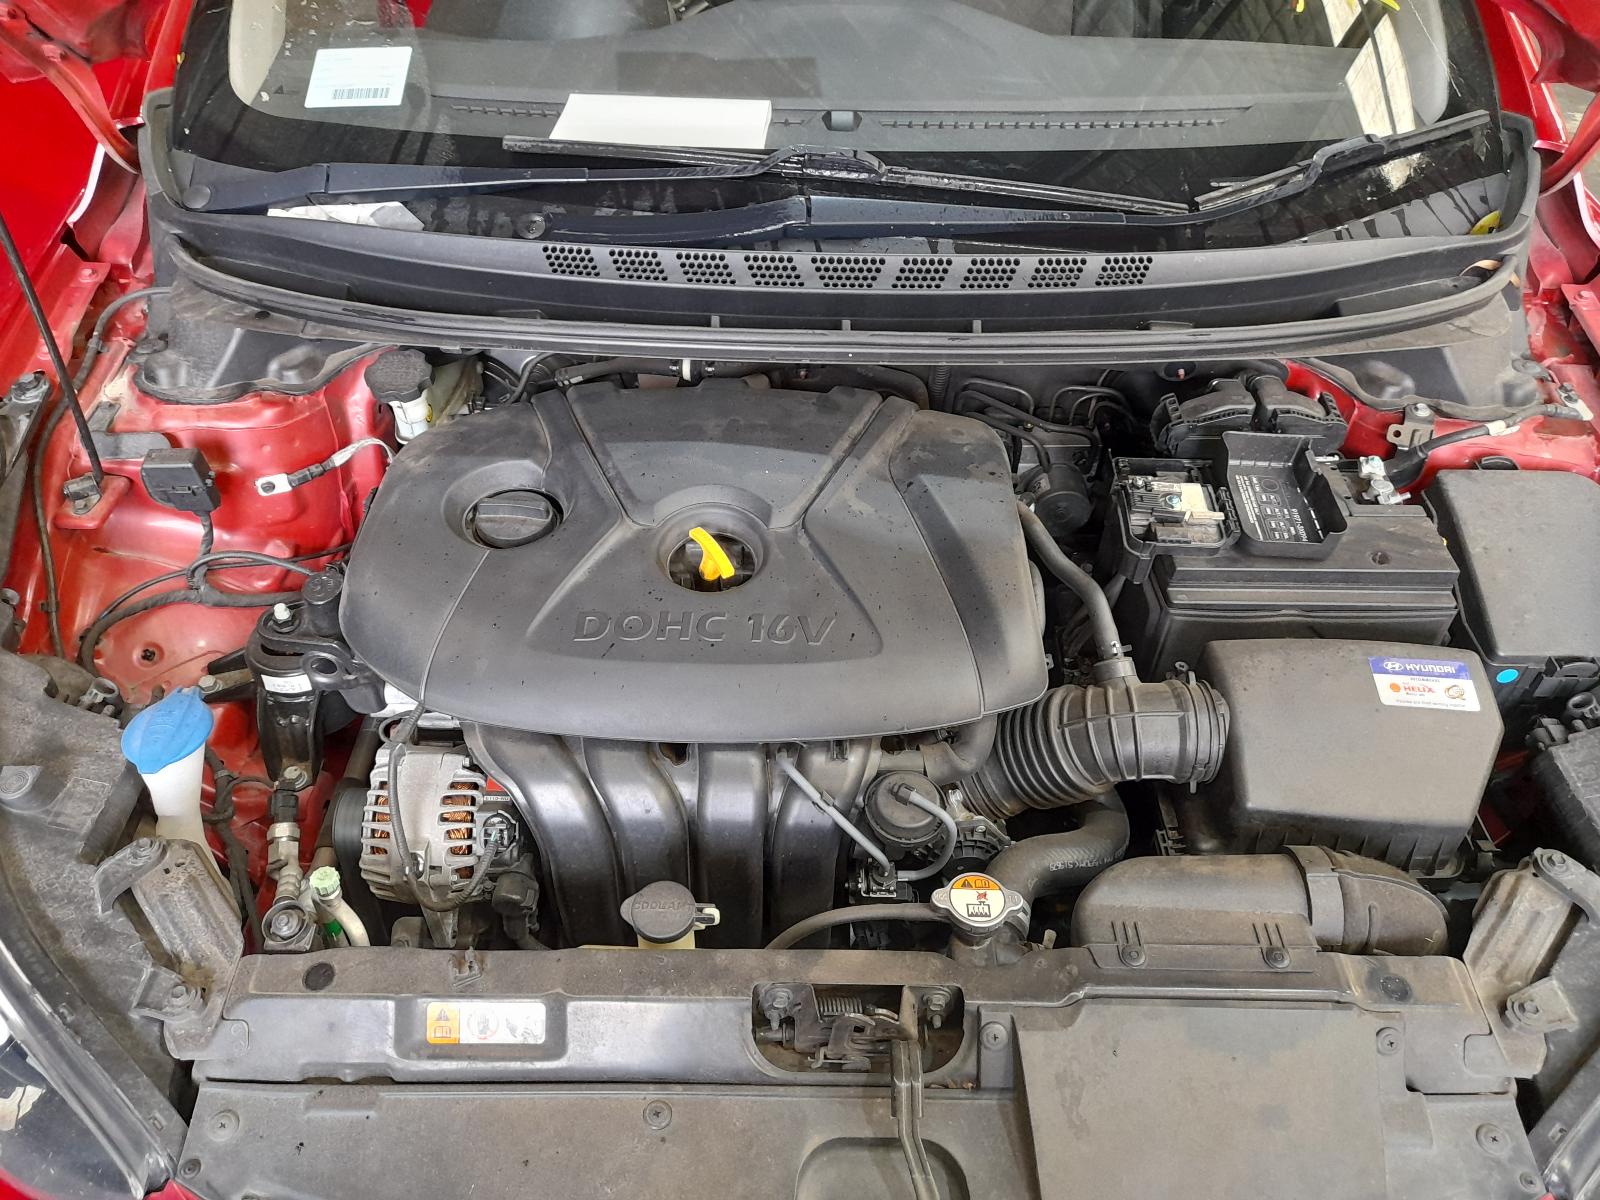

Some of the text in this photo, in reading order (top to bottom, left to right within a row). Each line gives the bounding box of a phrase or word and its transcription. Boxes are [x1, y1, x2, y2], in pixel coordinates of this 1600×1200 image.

[573, 611, 836, 646] DOHC 16V
[1405, 663, 1456, 674] HYUNDAI
[1404, 684, 1436, 693] HELIX
[631, 901, 686, 912] COOLAN
